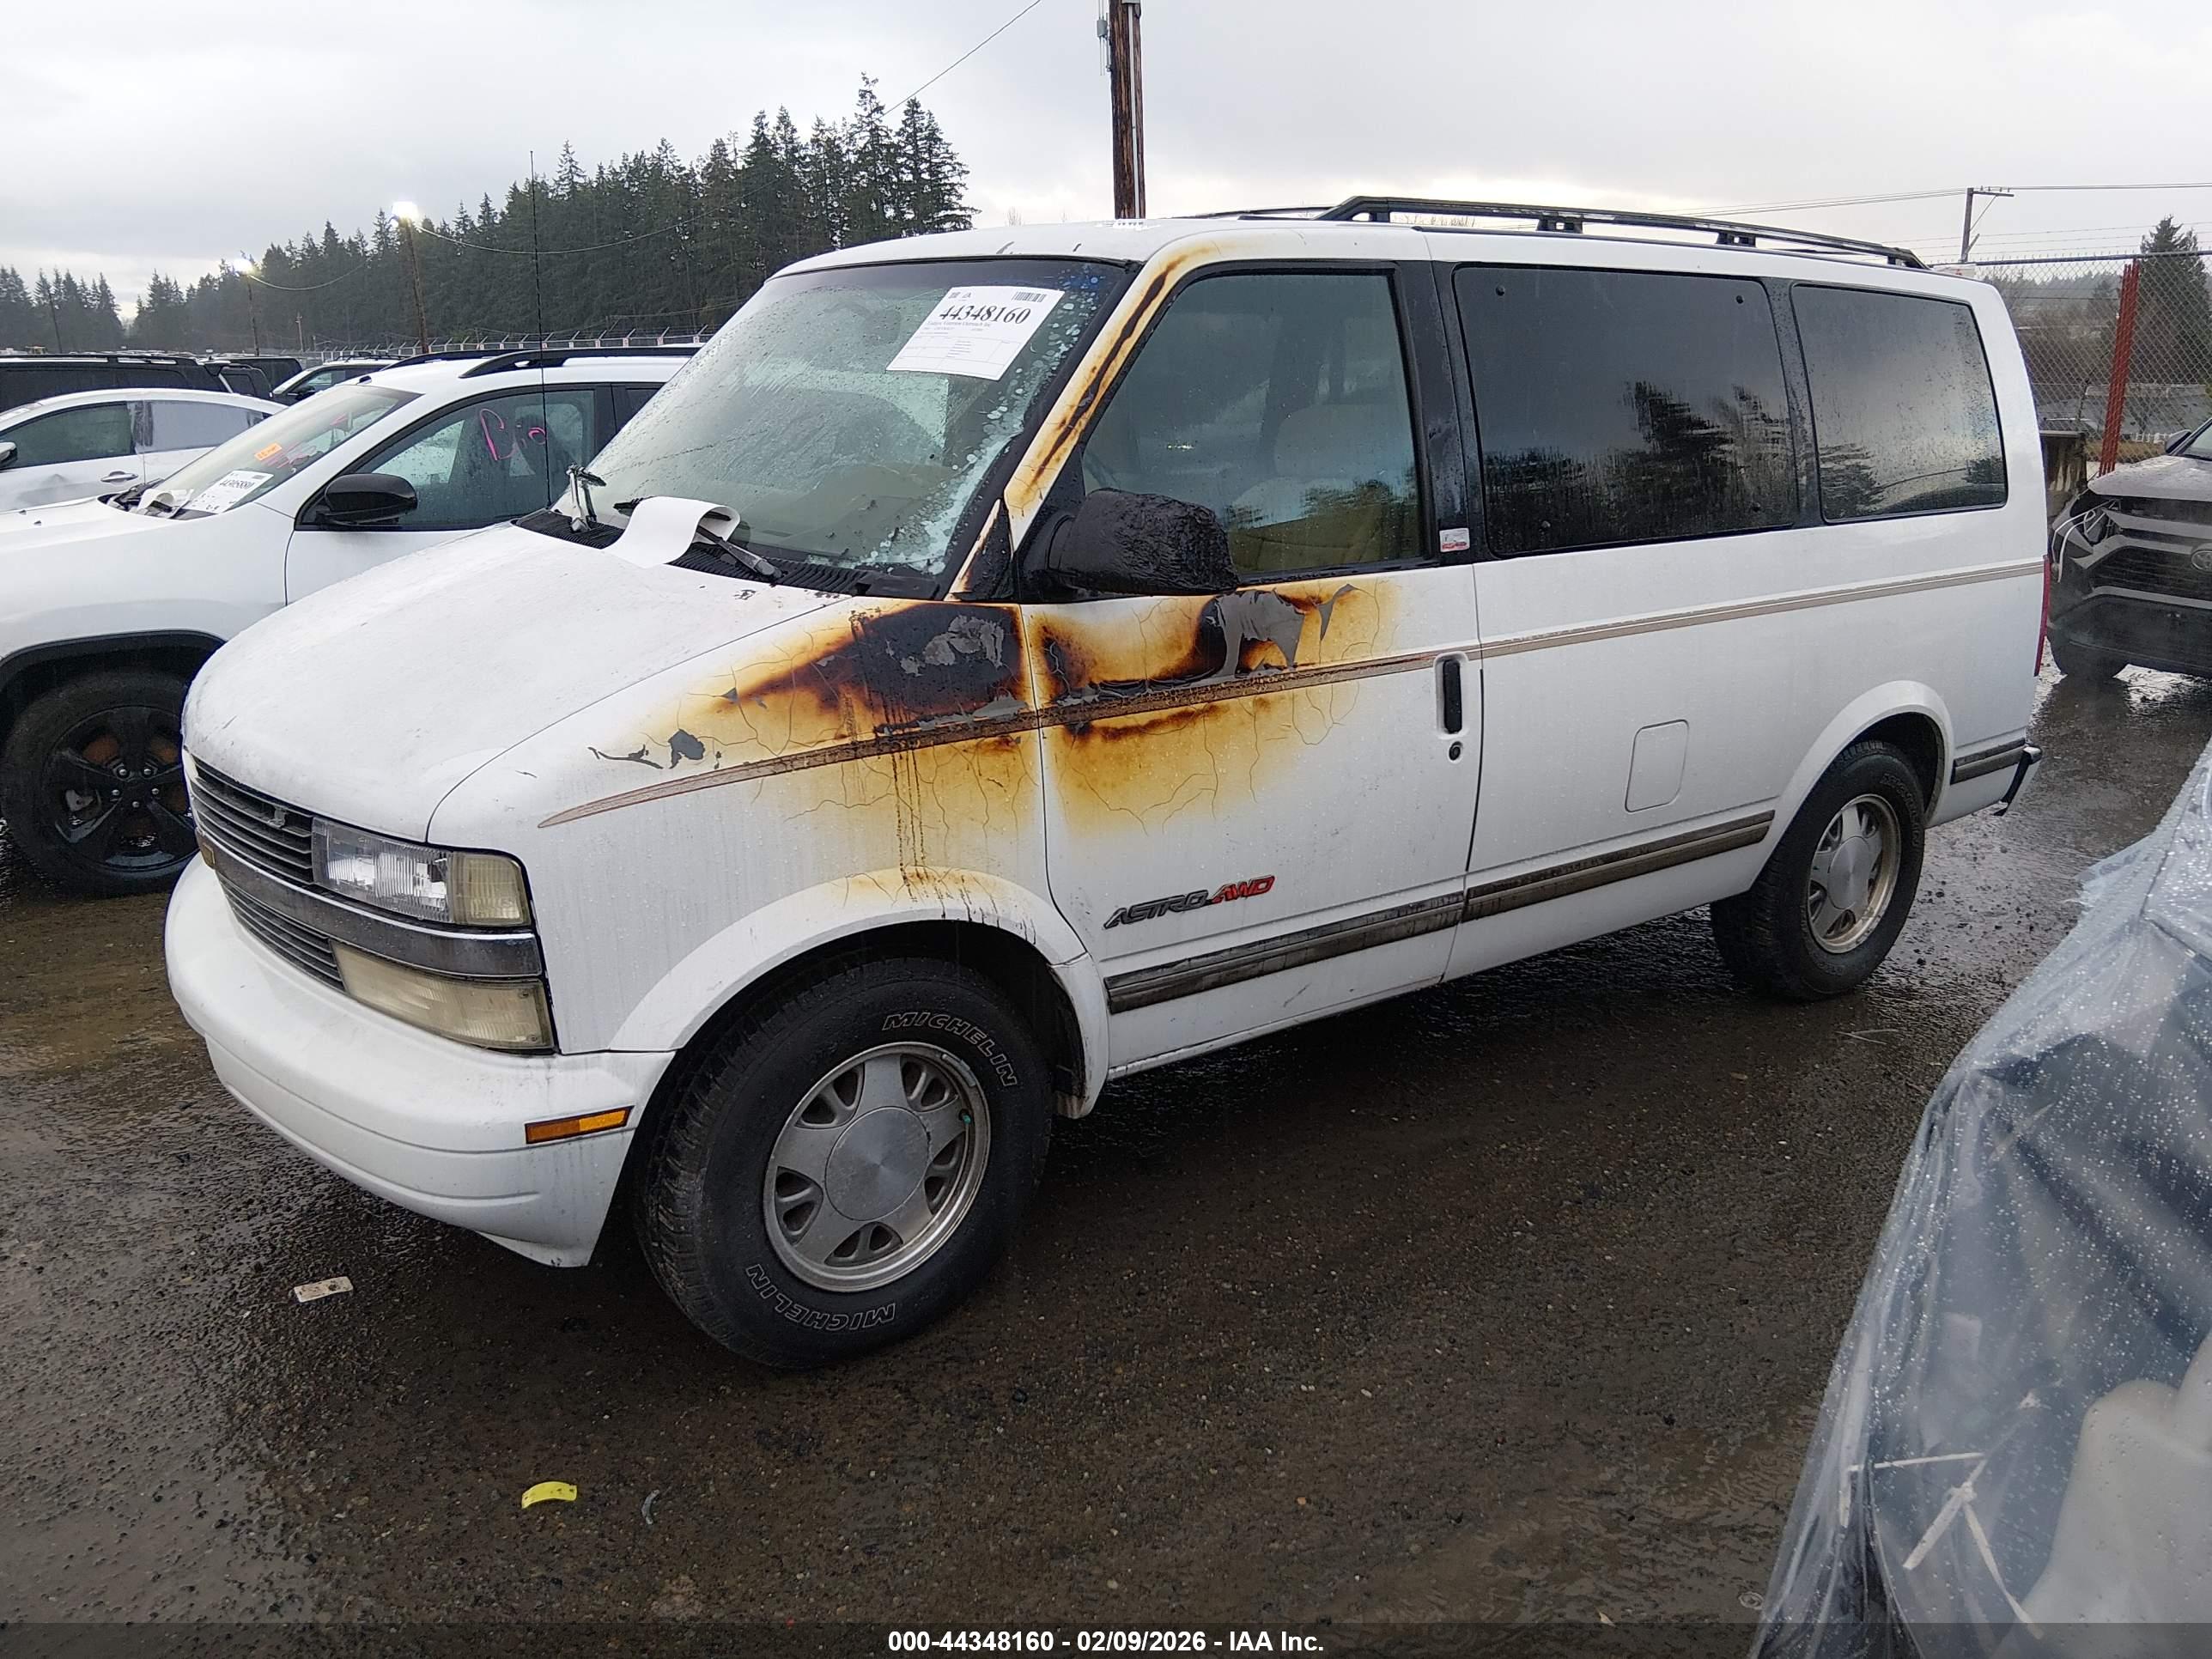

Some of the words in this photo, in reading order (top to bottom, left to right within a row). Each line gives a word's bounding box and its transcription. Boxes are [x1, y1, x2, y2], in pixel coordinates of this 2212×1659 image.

[939, 304, 1031, 325] 44348160
[1103, 890, 1210, 930] ASTRO
[1210, 874, 1276, 905] AWD
[882, 1012, 1018, 1087] MICHELIN
[745, 1263, 896, 1331] MICHELIN
